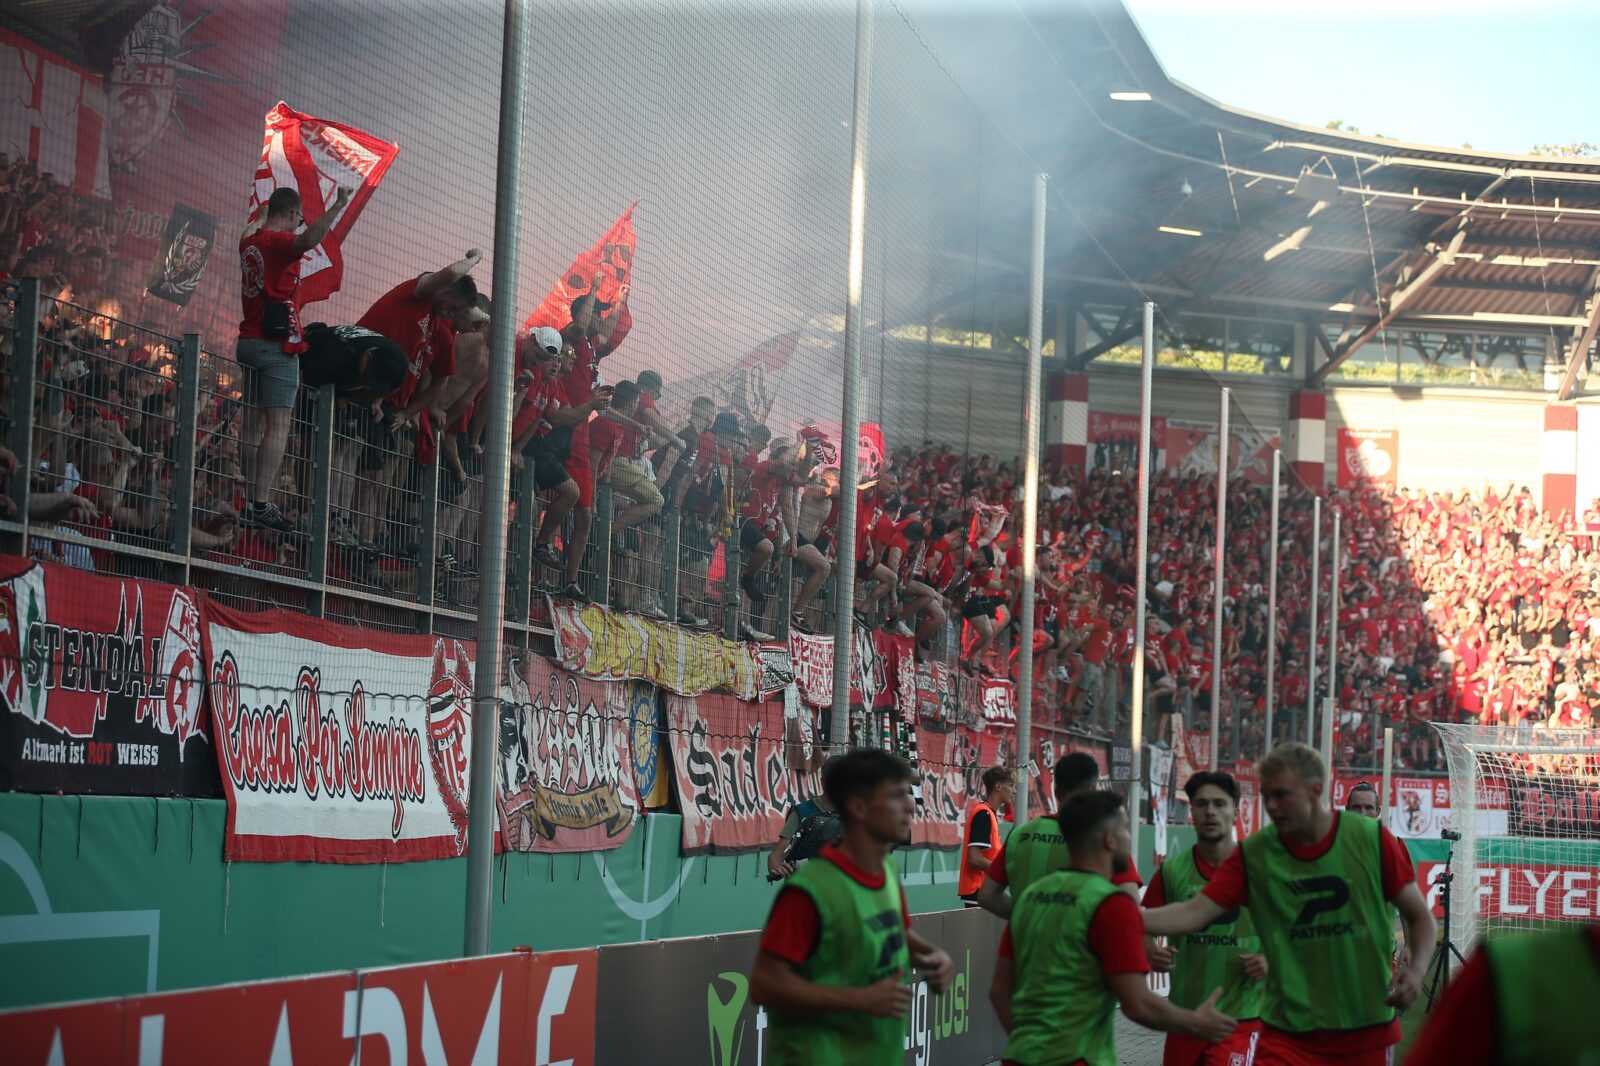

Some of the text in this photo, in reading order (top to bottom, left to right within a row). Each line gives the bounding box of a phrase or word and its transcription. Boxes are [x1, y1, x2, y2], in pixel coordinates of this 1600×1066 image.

[26, 620, 167, 698] STENDAL
[22, 737, 160, 766] Altmark ist ROT WEISS
[299, 665, 346, 800] Per
[345, 680, 425, 842] Sempre
[1474, 868, 1600, 916] FLYE
[1186, 934, 1238, 946] PATRICK
[1290, 923, 1354, 940] PATRICK
